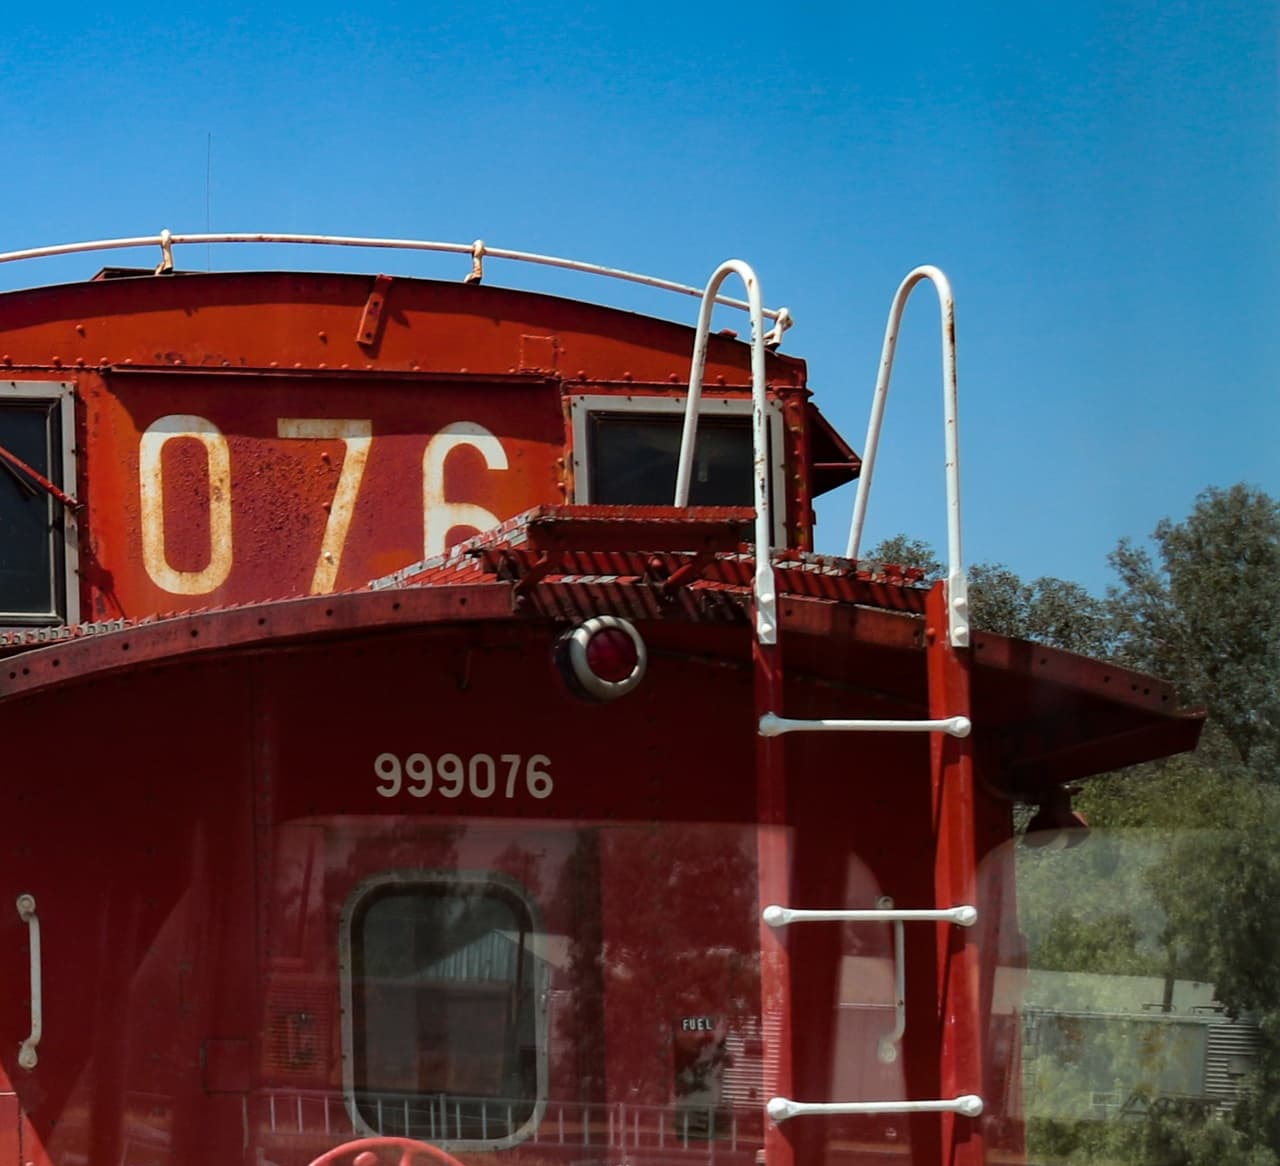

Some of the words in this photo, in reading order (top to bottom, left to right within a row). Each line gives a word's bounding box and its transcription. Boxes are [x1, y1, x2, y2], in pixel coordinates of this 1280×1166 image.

[138, 414, 510, 596] 076
[374, 752, 554, 799] 999076
[682, 1018, 713, 1031] FUEL
